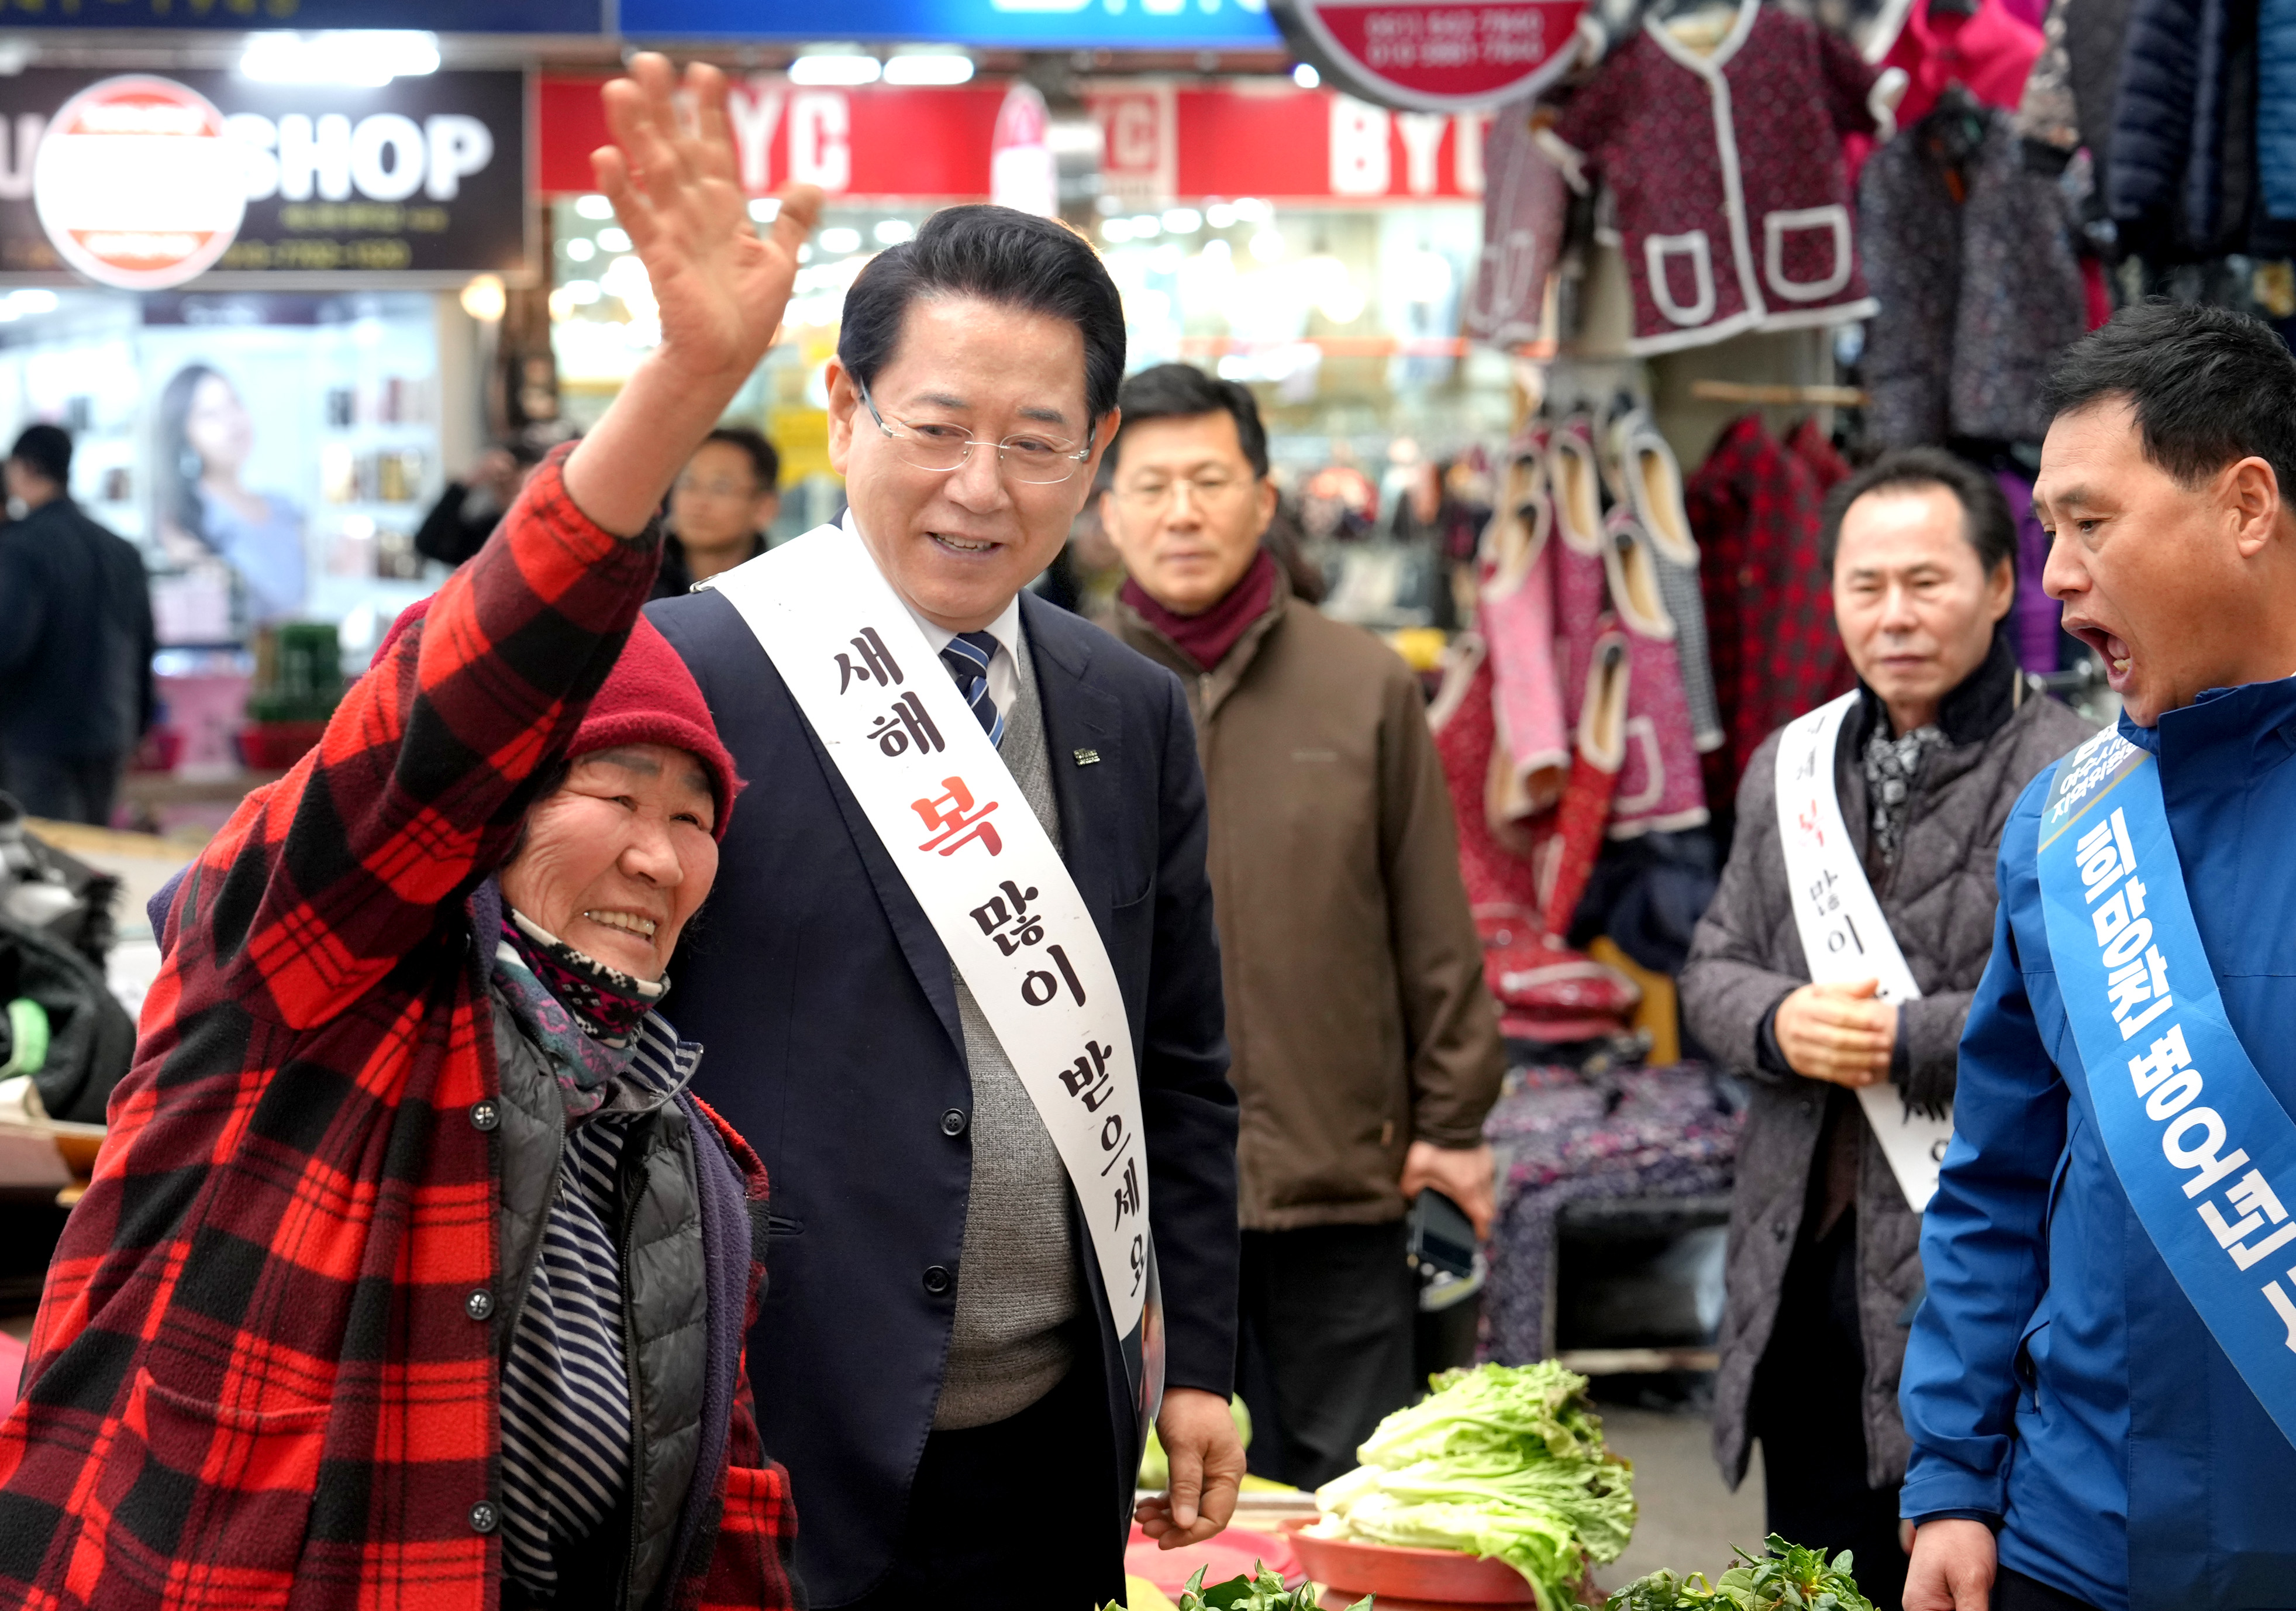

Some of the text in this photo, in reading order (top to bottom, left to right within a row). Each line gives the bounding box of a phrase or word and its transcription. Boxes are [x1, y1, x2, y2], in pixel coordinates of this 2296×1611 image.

[227, 113, 494, 201] SHOP
[671, 88, 851, 191] YC
[833, 626, 1147, 1297] 새해 복 많이 받으세요
[2076, 806, 2296, 1272] 희망찬 병오년
